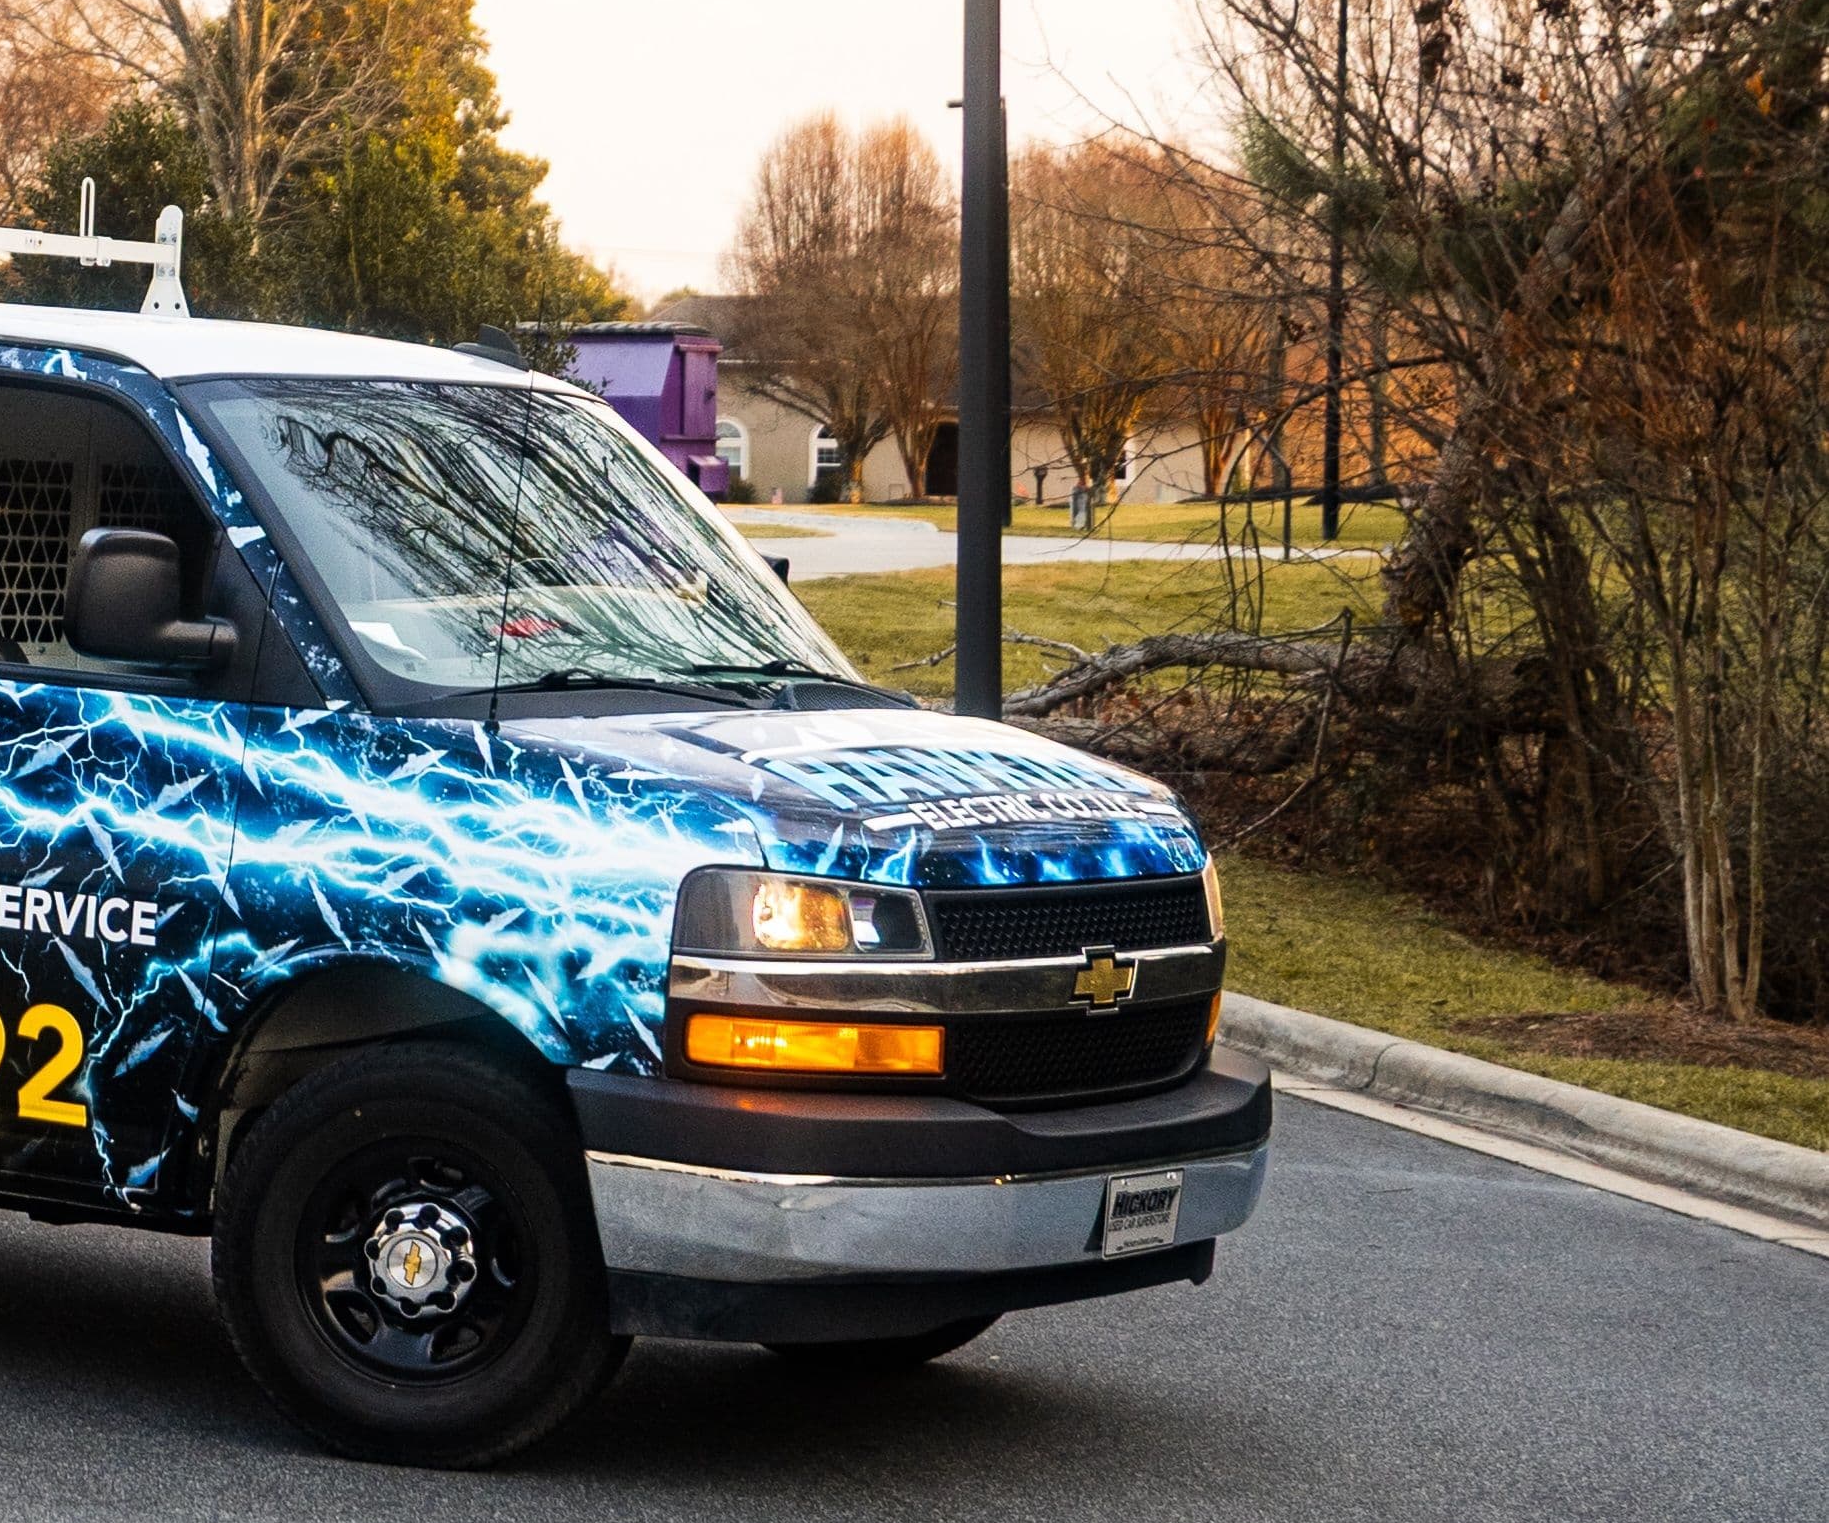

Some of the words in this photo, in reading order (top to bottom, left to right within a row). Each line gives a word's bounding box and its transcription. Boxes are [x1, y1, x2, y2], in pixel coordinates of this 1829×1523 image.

[908, 792, 1051, 831] ELECTRIC
[1085, 792, 1148, 820] LLC
[1111, 1185, 1180, 1220] HICKORY
